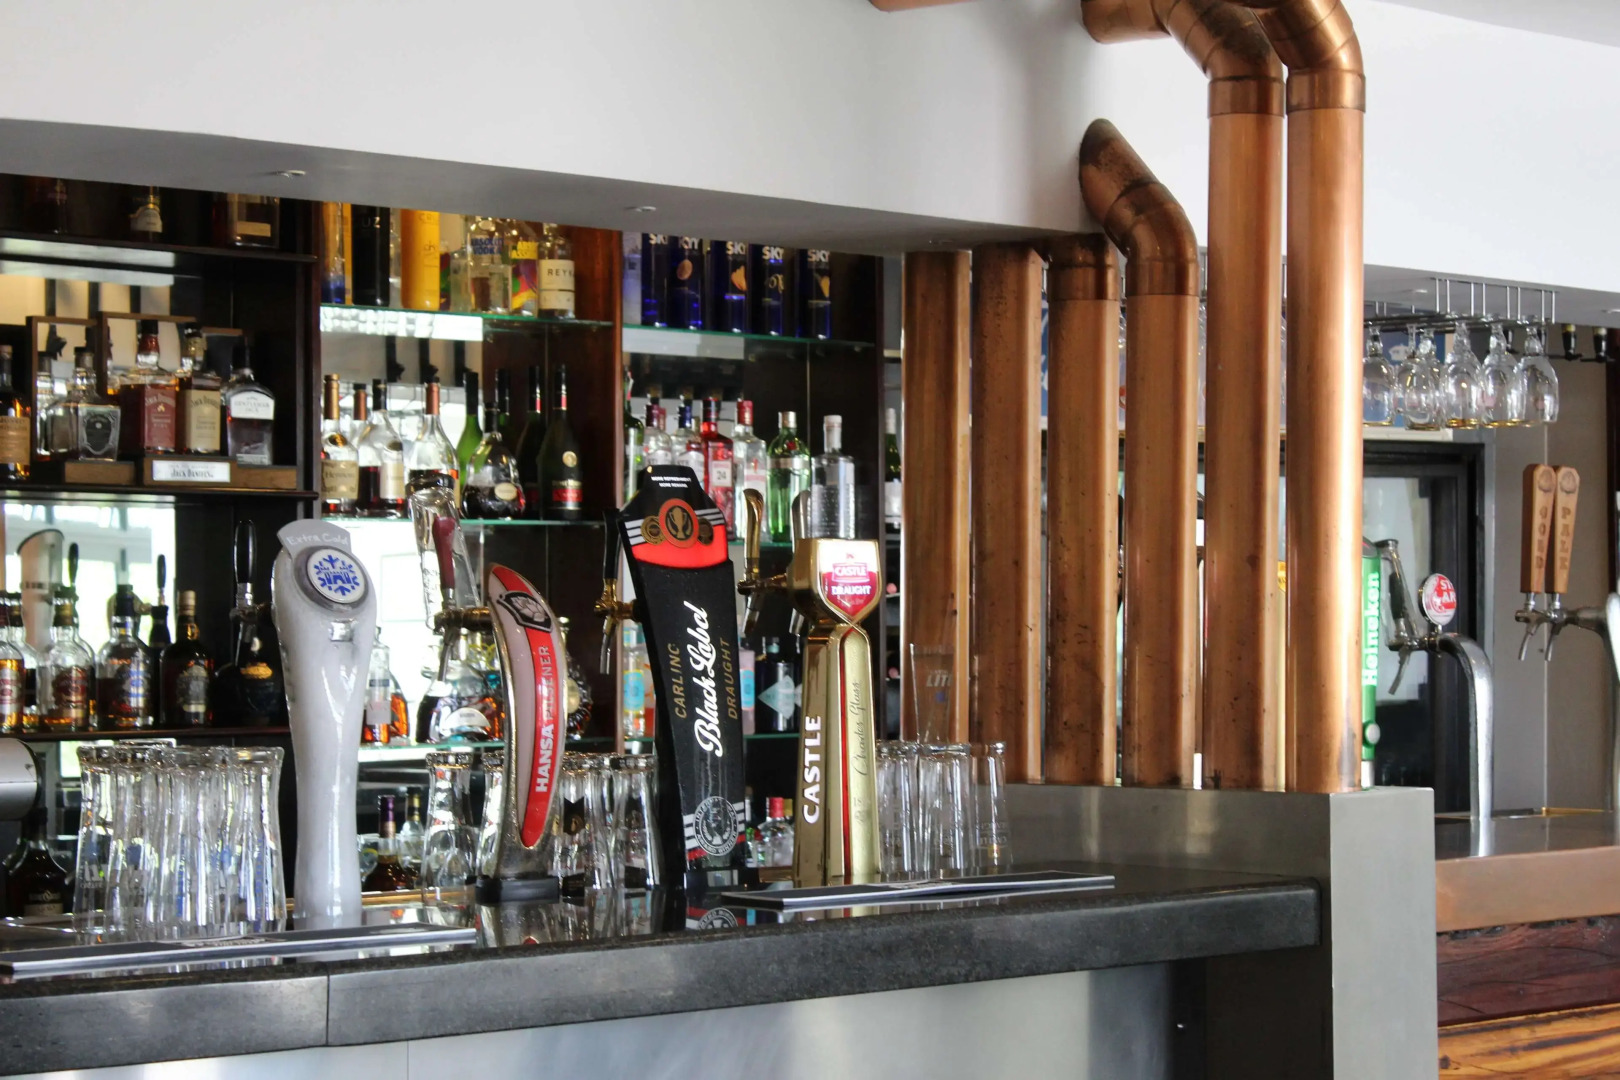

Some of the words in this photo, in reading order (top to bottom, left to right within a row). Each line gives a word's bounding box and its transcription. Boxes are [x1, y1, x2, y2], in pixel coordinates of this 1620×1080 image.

[716, 470, 727, 480] 24
[831, 585, 872, 596] DRAUGHT
[834, 566, 867, 577] CASTLE
[683, 600, 717, 678] Label
[1362, 571, 1380, 687] Heineken
[538, 646, 556, 720] PILSENER
[667, 642, 687, 719] CARLING
[692, 676, 724, 758] Black
[719, 637, 738, 720] DRAUGHT
[535, 724, 555, 793] HANSA
[803, 715, 822, 824] CASTLE
